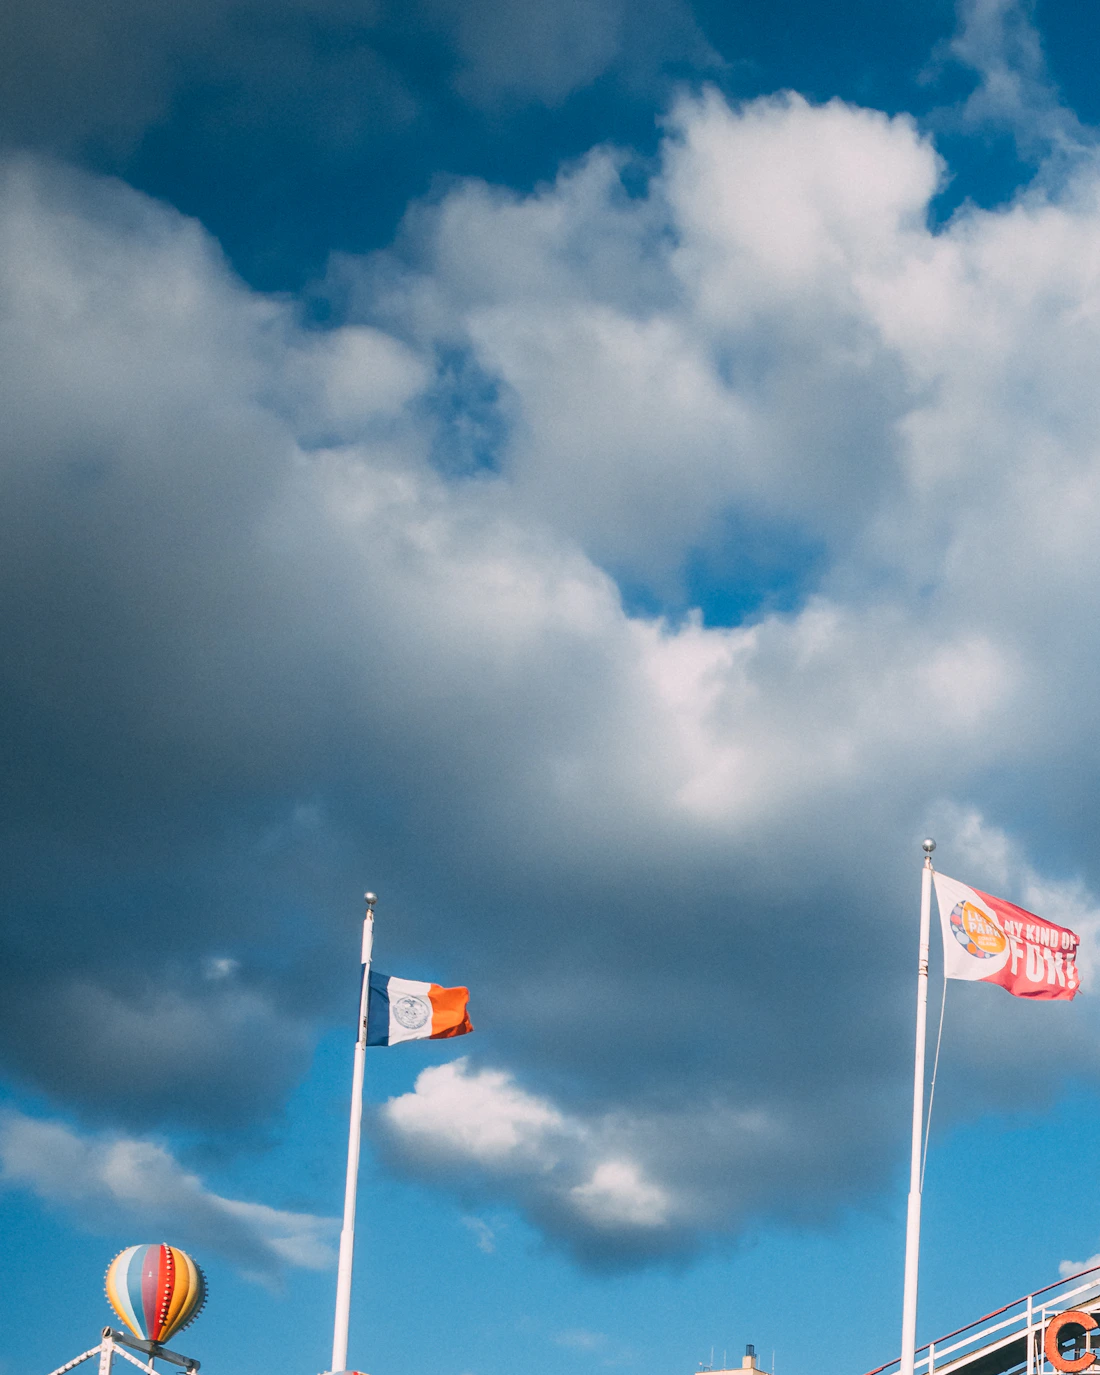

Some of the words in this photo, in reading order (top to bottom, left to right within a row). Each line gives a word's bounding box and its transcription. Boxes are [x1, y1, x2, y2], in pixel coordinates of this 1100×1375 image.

[969, 921, 1002, 938] PARK
[1004, 919, 1023, 938] MY
[1026, 924, 1059, 948] KIND
[1062, 931, 1077, 951] OF
[1008, 934, 1076, 990] FUN!
